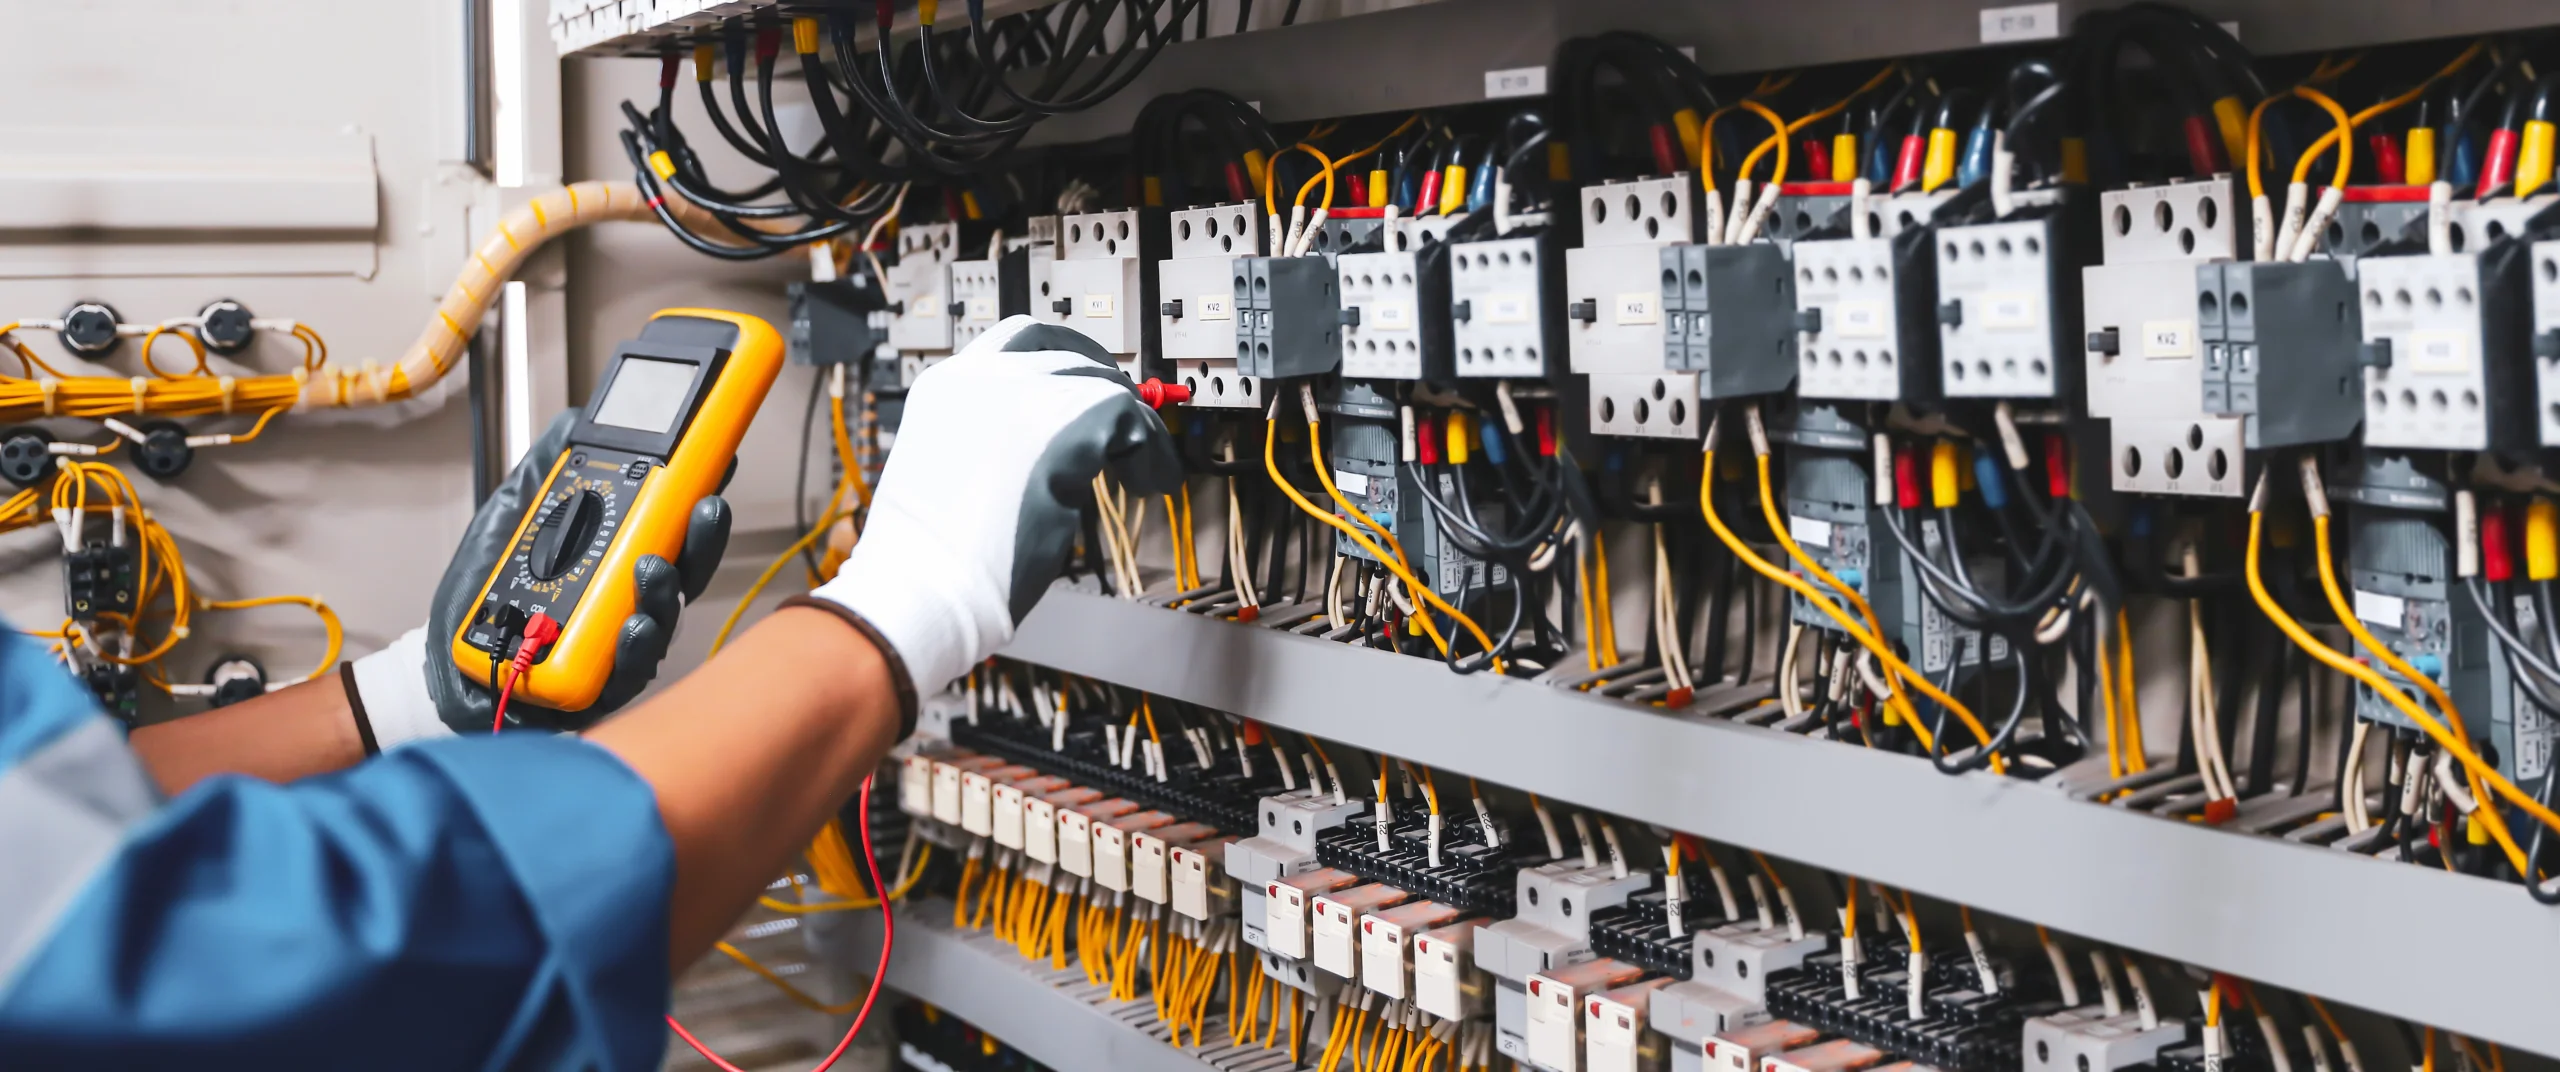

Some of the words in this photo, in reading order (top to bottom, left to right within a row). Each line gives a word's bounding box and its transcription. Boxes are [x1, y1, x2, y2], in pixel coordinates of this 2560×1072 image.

[1092, 301, 1104, 309] KV1
[1207, 302, 1221, 312] KV2
[1627, 303, 1645, 314] KV2
[2157, 333, 2177, 346] KV2
[1379, 820, 1388, 836] 221
[1482, 812, 1494, 830] 223
[1670, 898, 1680, 917] 221
[1845, 959, 1857, 979] 221
[1504, 1039, 1518, 1053] 2F1
